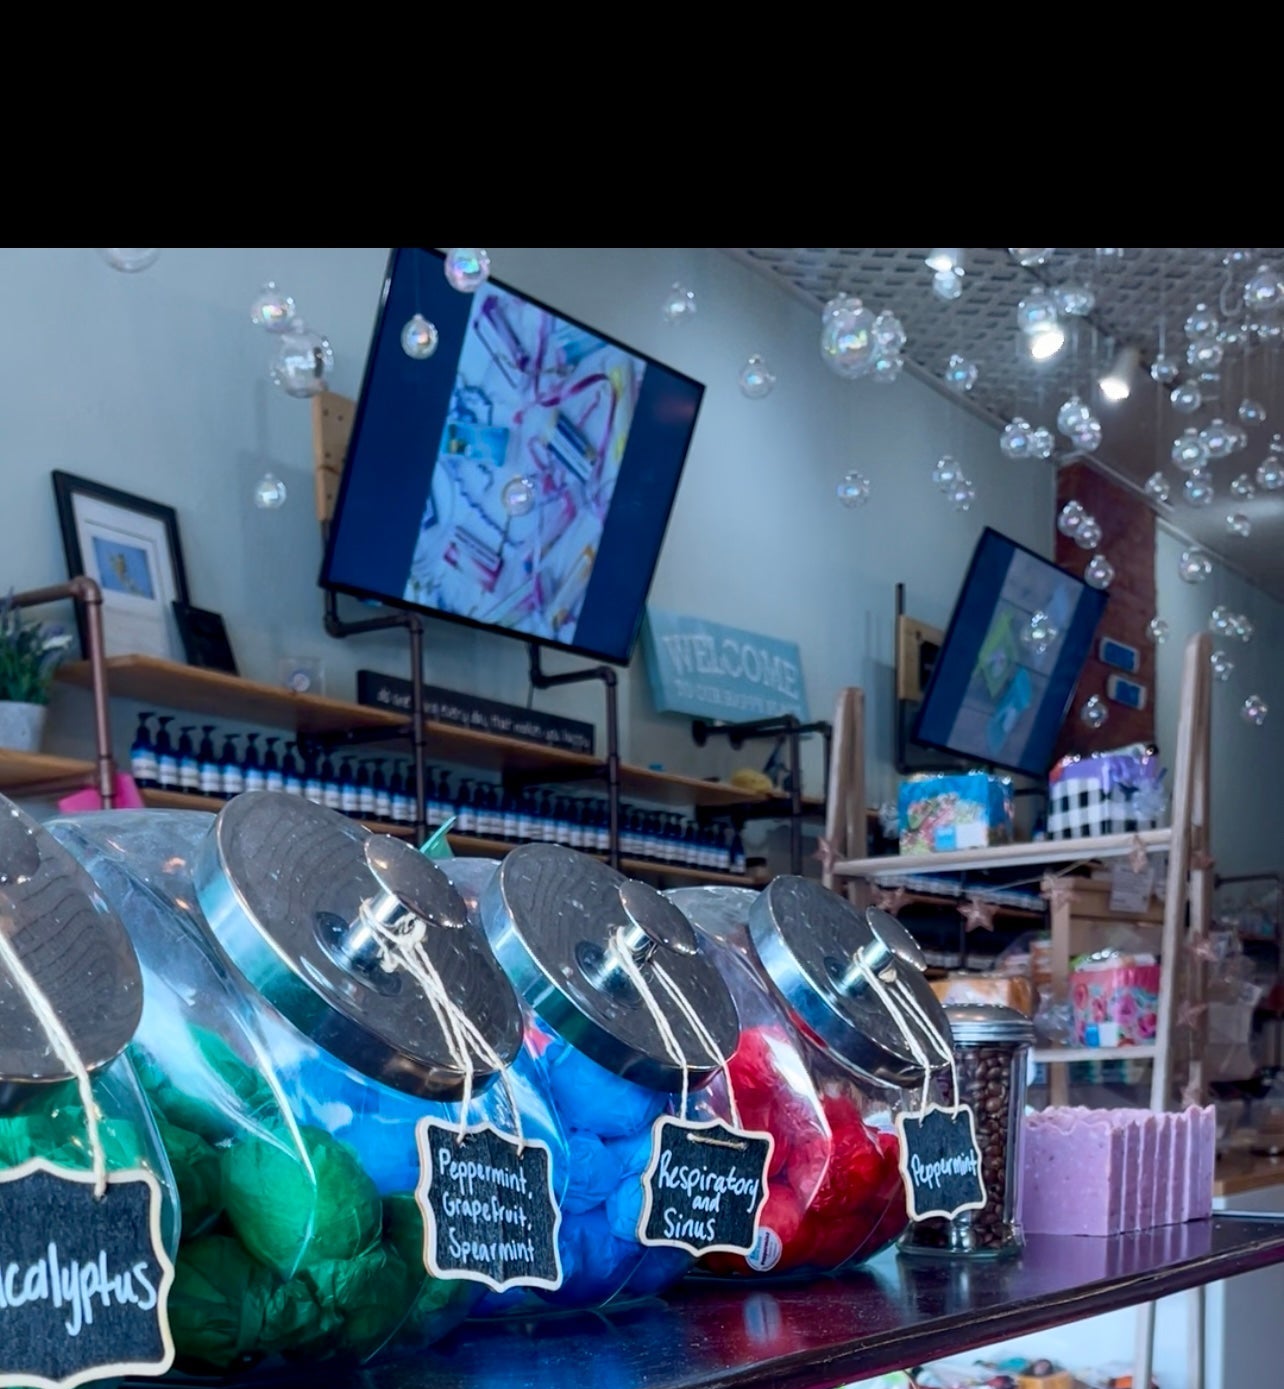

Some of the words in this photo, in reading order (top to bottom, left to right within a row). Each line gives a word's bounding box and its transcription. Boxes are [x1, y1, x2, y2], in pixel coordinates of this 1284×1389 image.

[662, 633, 799, 700] WELCOME
[658, 1149, 760, 1214] Respiratory
[911, 1148, 978, 1190] Peppermint
[692, 1191, 721, 1213] and
[664, 1207, 716, 1242] Sinus
[449, 1227, 534, 1263] Spearmint
